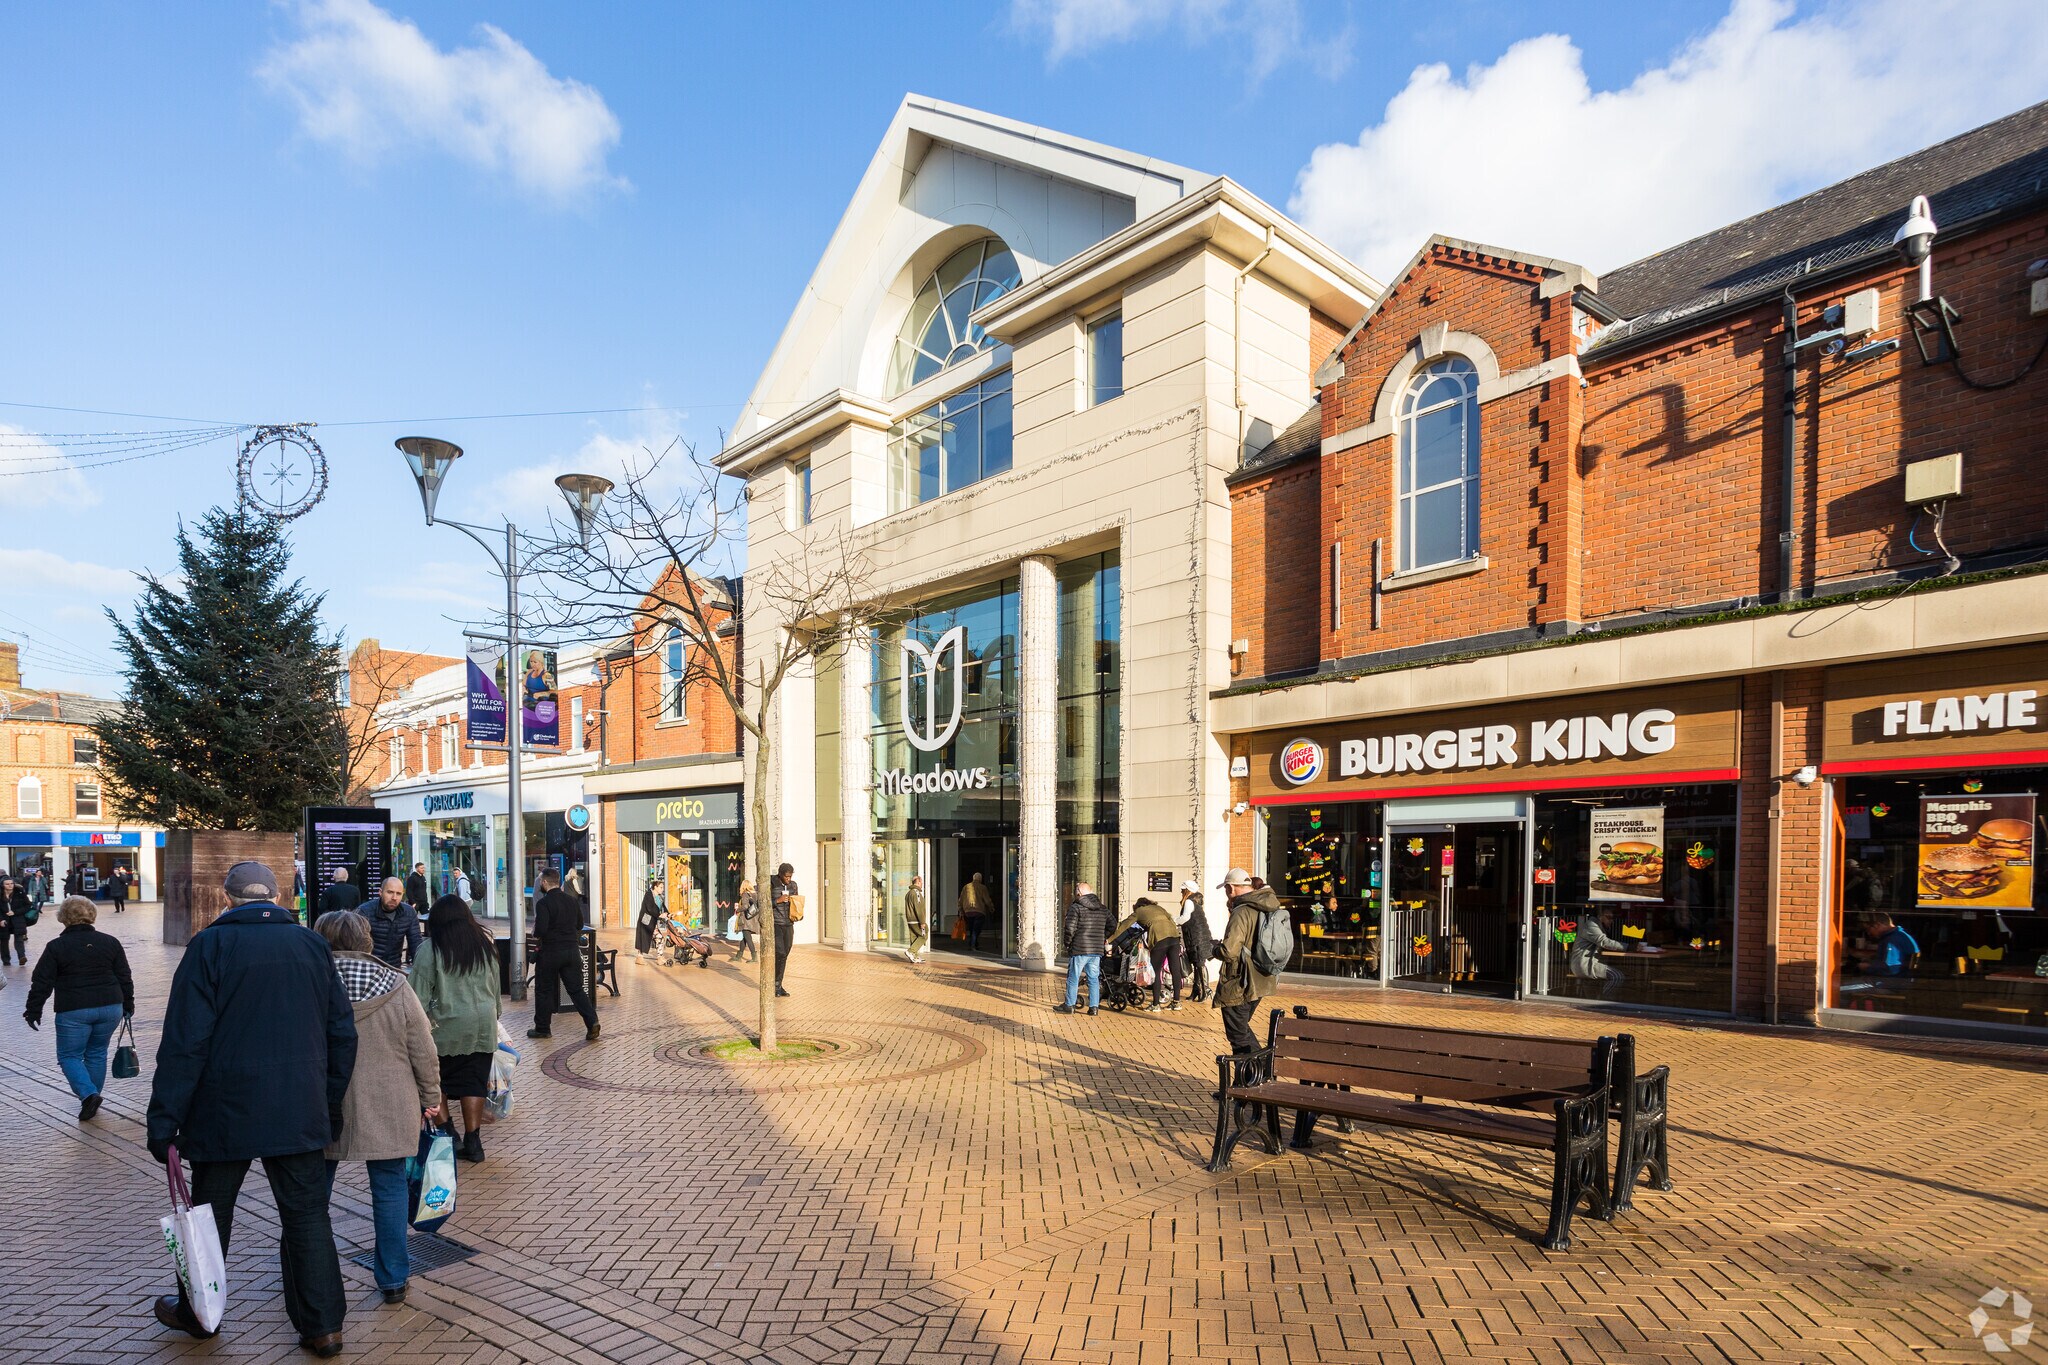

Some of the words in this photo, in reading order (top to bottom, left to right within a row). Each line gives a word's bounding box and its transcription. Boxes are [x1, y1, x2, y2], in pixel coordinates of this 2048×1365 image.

[471, 704, 504, 712] JANUARY?
[1883, 690, 2037, 735] FLAME
[1340, 724, 1518, 777] BURGER
[1531, 709, 1676, 762] KING
[1286, 746, 1314, 764] BURGER
[1286, 754, 1314, 775] KING
[881, 763, 987, 796] Meadows
[433, 791, 474, 811] BARCLAYS
[656, 796, 704, 824] preto
[1926, 800, 1993, 813] Memphis
[698, 819, 720, 827] BRAZILIAN
[1926, 812, 1958, 824] BBQ
[1925, 823, 1969, 835] Kings
[91, 833, 122, 844] METRO
